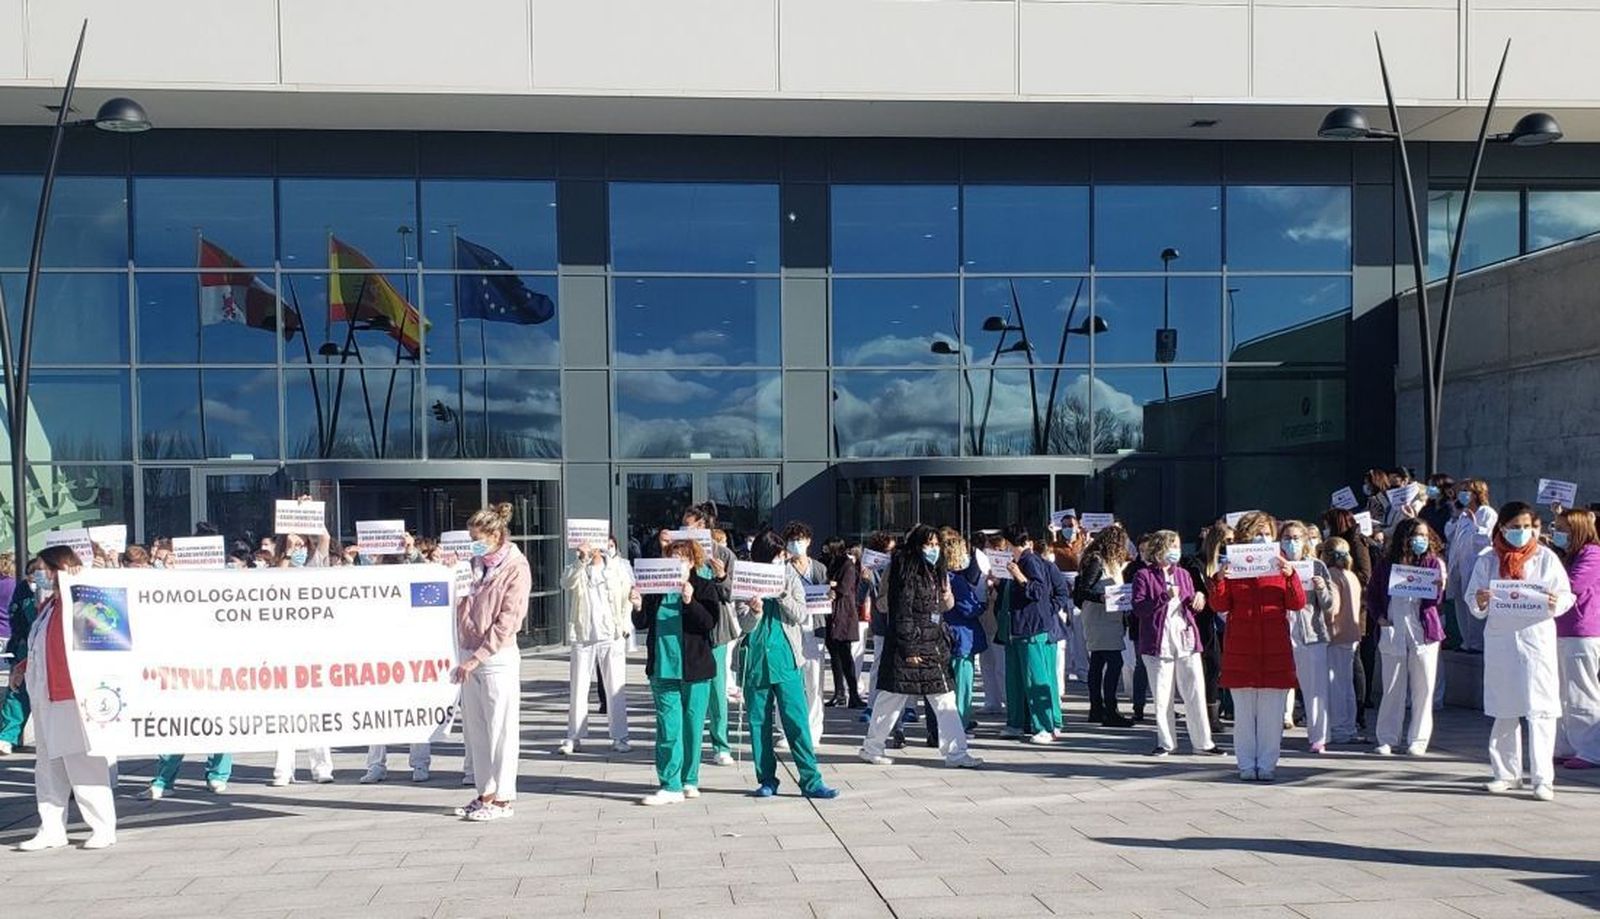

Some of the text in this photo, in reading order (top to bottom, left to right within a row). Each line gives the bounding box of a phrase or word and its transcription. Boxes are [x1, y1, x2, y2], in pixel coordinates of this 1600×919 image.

[138, 584, 291, 604] HOMOLOGACIÓN
[298, 585, 402, 600] EDUCATIVA
[215, 606, 334, 622] CON EUROPA
[294, 664, 323, 689] DE
[329, 661, 405, 687] GRADO
[131, 705, 453, 737] TÉCNICOS SUPERIORES SANITARIOS
